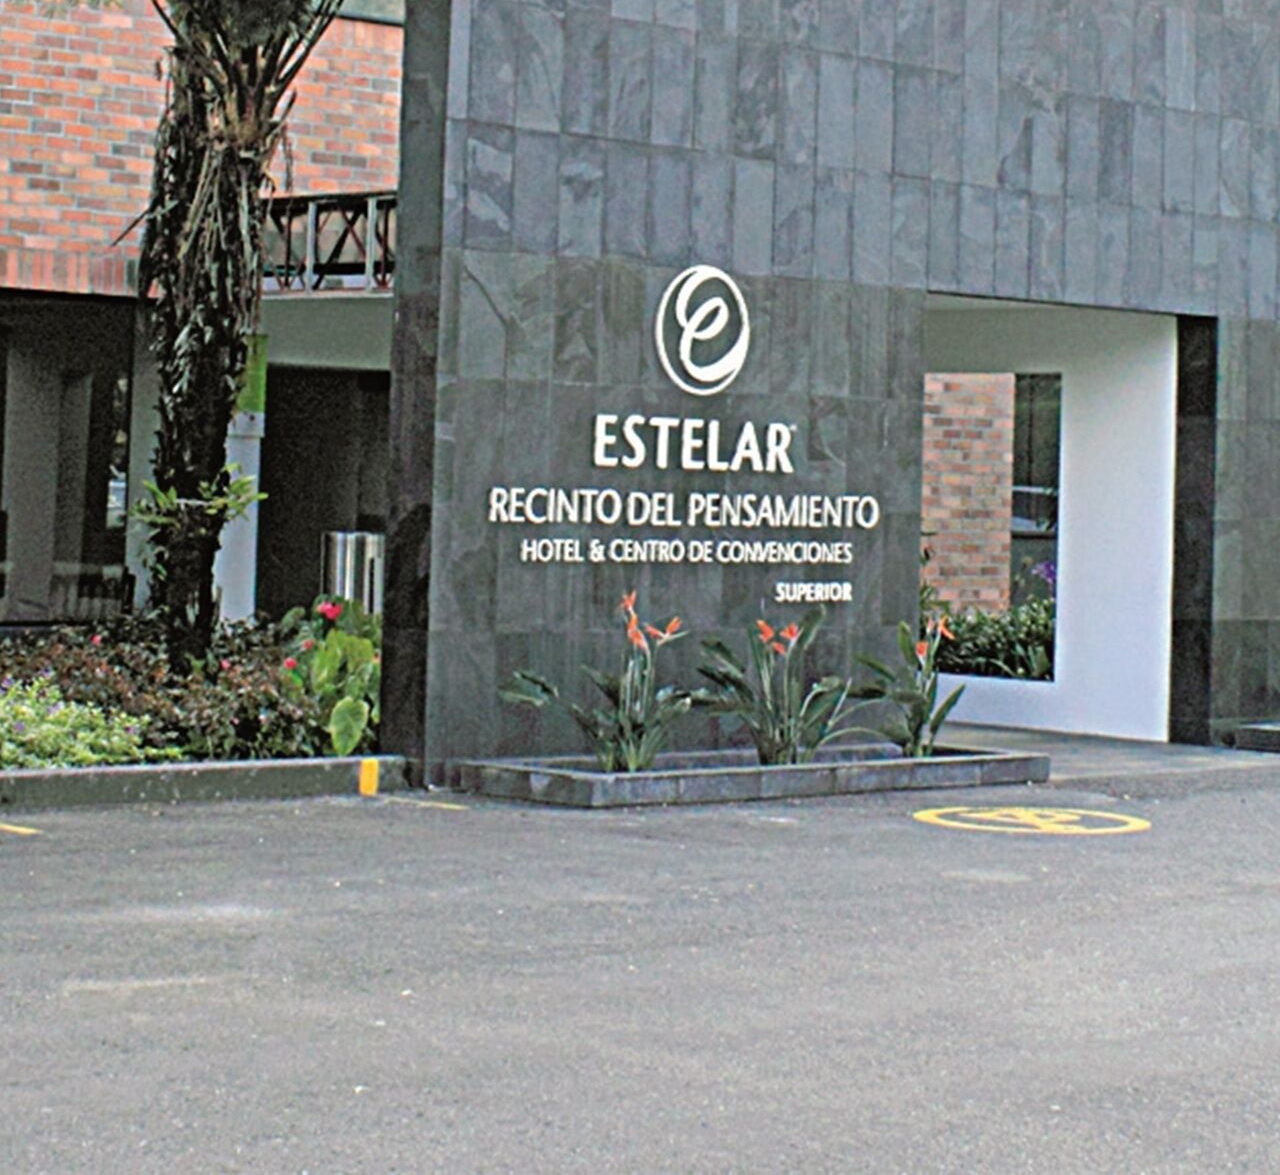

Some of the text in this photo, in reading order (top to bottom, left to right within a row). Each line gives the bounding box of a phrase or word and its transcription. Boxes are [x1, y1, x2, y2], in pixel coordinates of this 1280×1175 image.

[593, 413, 795, 473] ESTELAR
[488, 487, 880, 529] RECINTO DEL PENSAMIENTO
[521, 538, 853, 564] HOTEL & CENTRO DE CONVENCIONES
[774, 581, 853, 602] SUPERIOR
